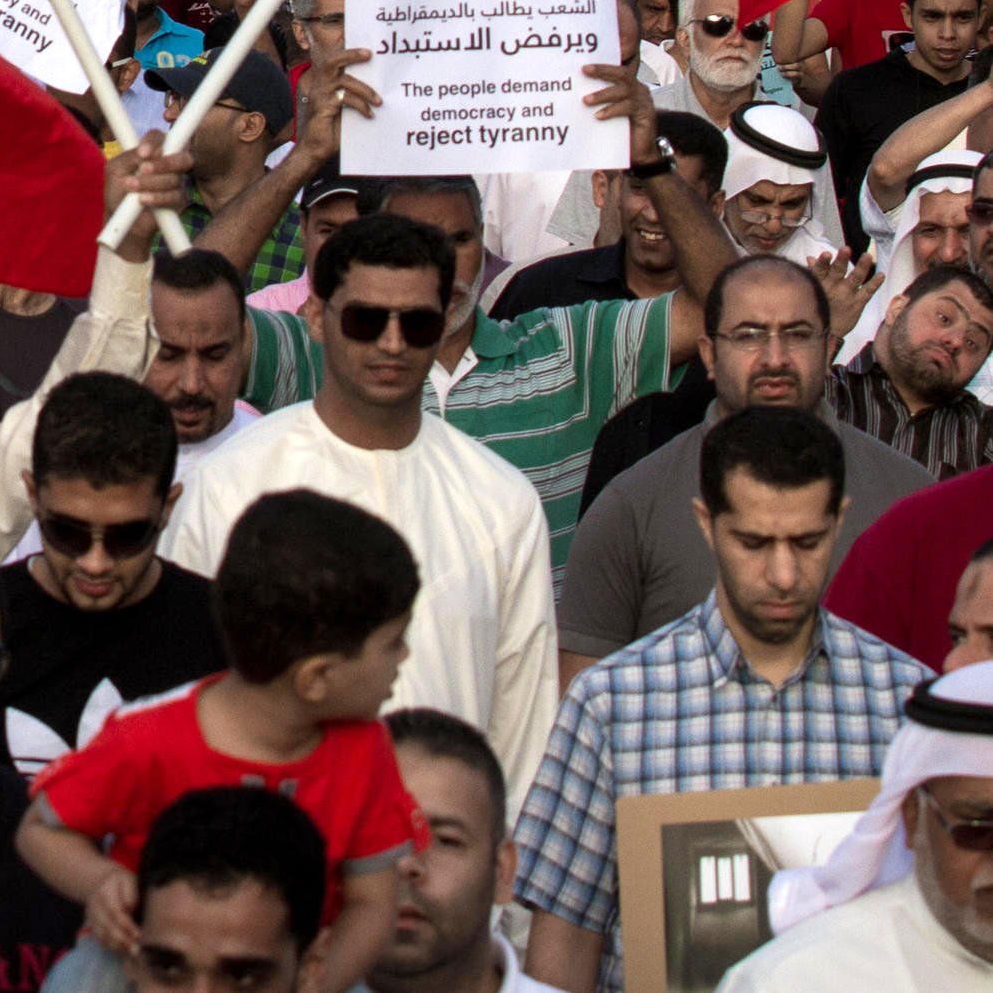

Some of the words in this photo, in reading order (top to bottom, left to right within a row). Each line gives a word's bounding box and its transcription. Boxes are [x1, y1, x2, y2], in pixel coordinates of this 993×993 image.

[21, 1, 52, 26] and
[376, 3, 475, 25] بالديمقراطية
[481, 1, 533, 22] يطالب
[377, 27, 491, 59] الاستبداد
[501, 26, 598, 55] ويرفض
[401, 82, 433, 97] The
[438, 79, 496, 99] people
[501, 77, 573, 93] demand
[421, 106, 515, 122] democracy
[521, 103, 554, 117] and
[407, 126, 472, 149] reject
[479, 125, 569, 147] tyranny
